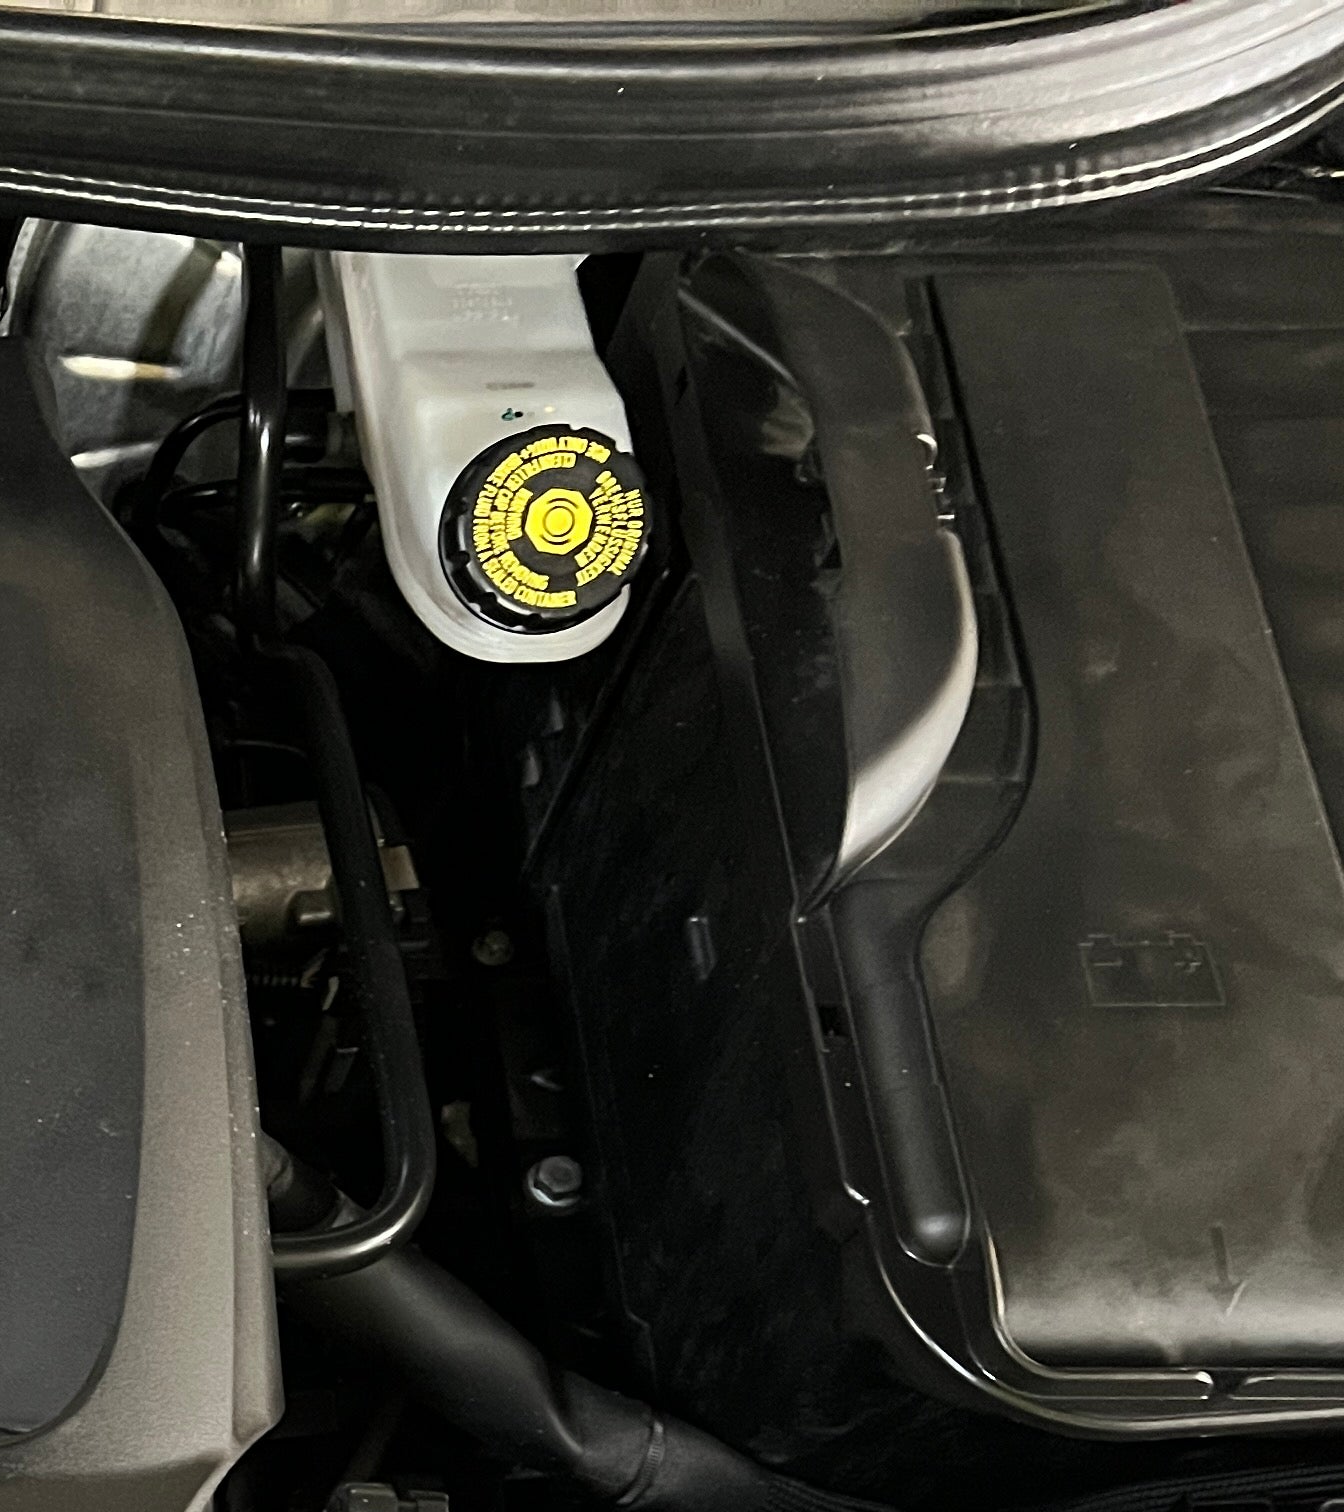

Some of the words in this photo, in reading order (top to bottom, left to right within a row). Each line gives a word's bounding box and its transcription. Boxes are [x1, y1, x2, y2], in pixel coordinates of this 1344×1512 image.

[473, 484, 498, 517] FLUID
[624, 489, 644, 517] NUR
[473, 518, 492, 552] FROM
[606, 520, 644, 576] ORIGINAL
[477, 550, 494, 562] A
